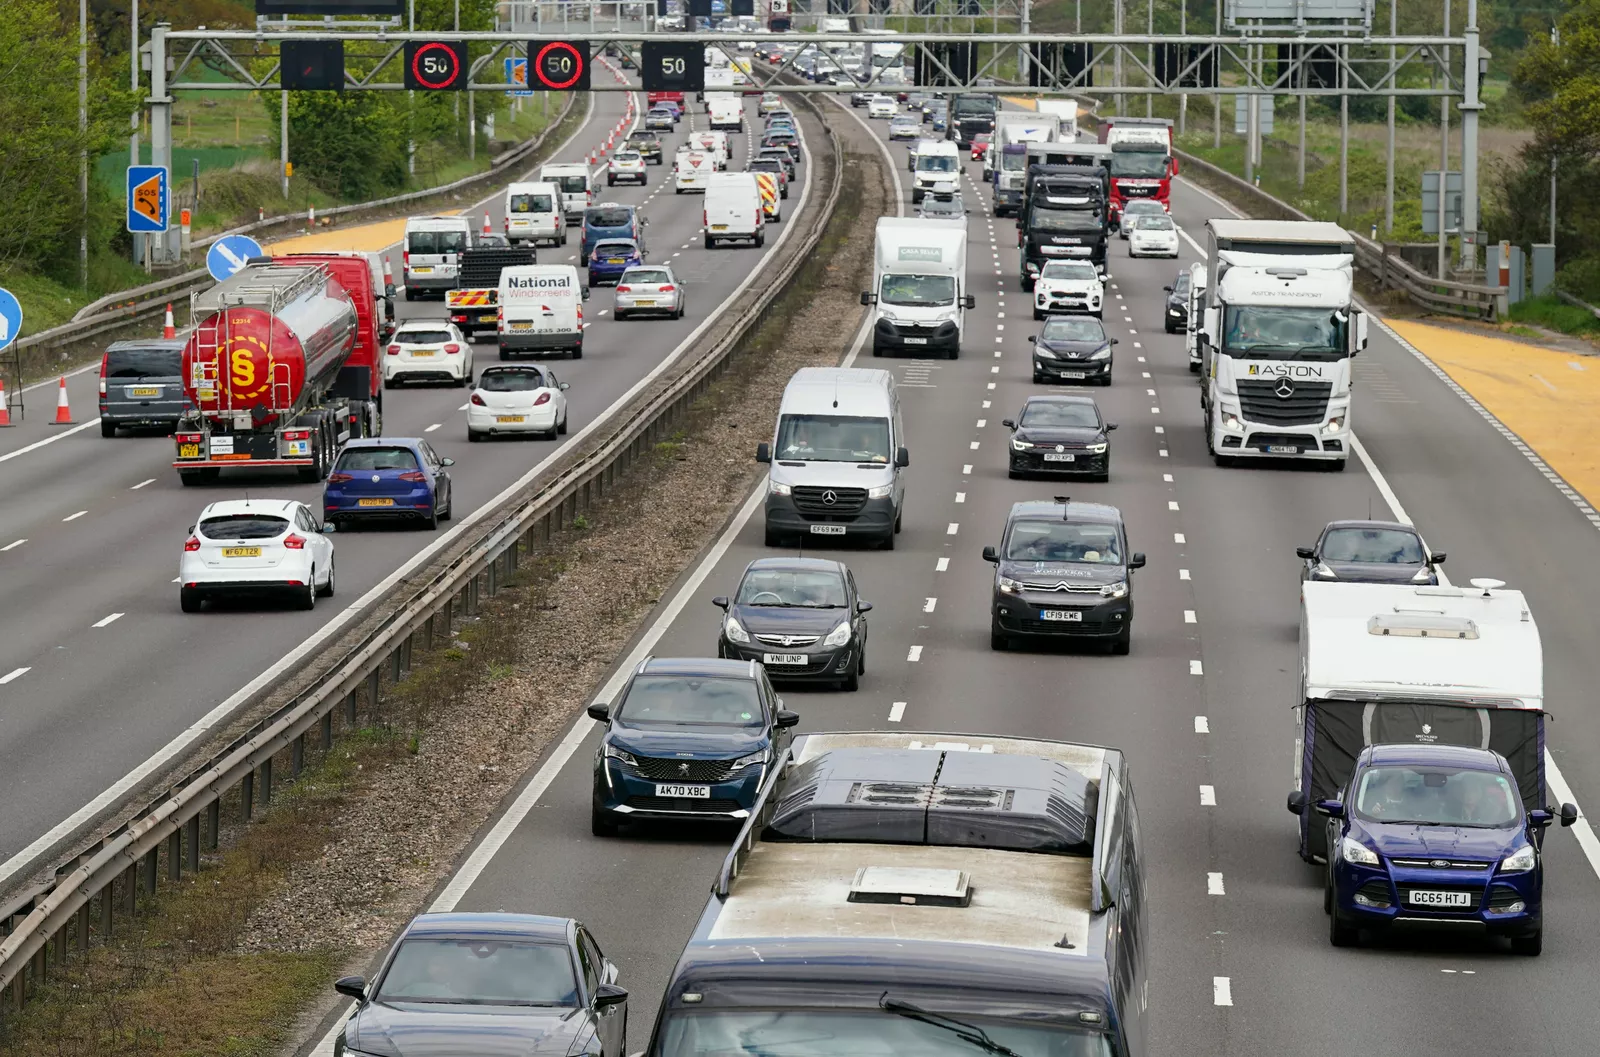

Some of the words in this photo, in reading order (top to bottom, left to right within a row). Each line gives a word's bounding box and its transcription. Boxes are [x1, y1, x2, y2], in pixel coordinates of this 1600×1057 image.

[424, 57, 448, 74] 50
[547, 57, 571, 74] 50
[662, 57, 686, 74] 50
[508, 276, 570, 288] National
[509, 289, 571, 298] Windscreens
[1261, 364, 1322, 377] ASTON
[1045, 611, 1062, 619] CF19
[787, 655, 801, 663] UNP
[660, 785, 685, 796] AK70
[687, 786, 706, 796] XBC
[1414, 892, 1442, 903] GC65
[1445, 893, 1467, 904] HTJ
